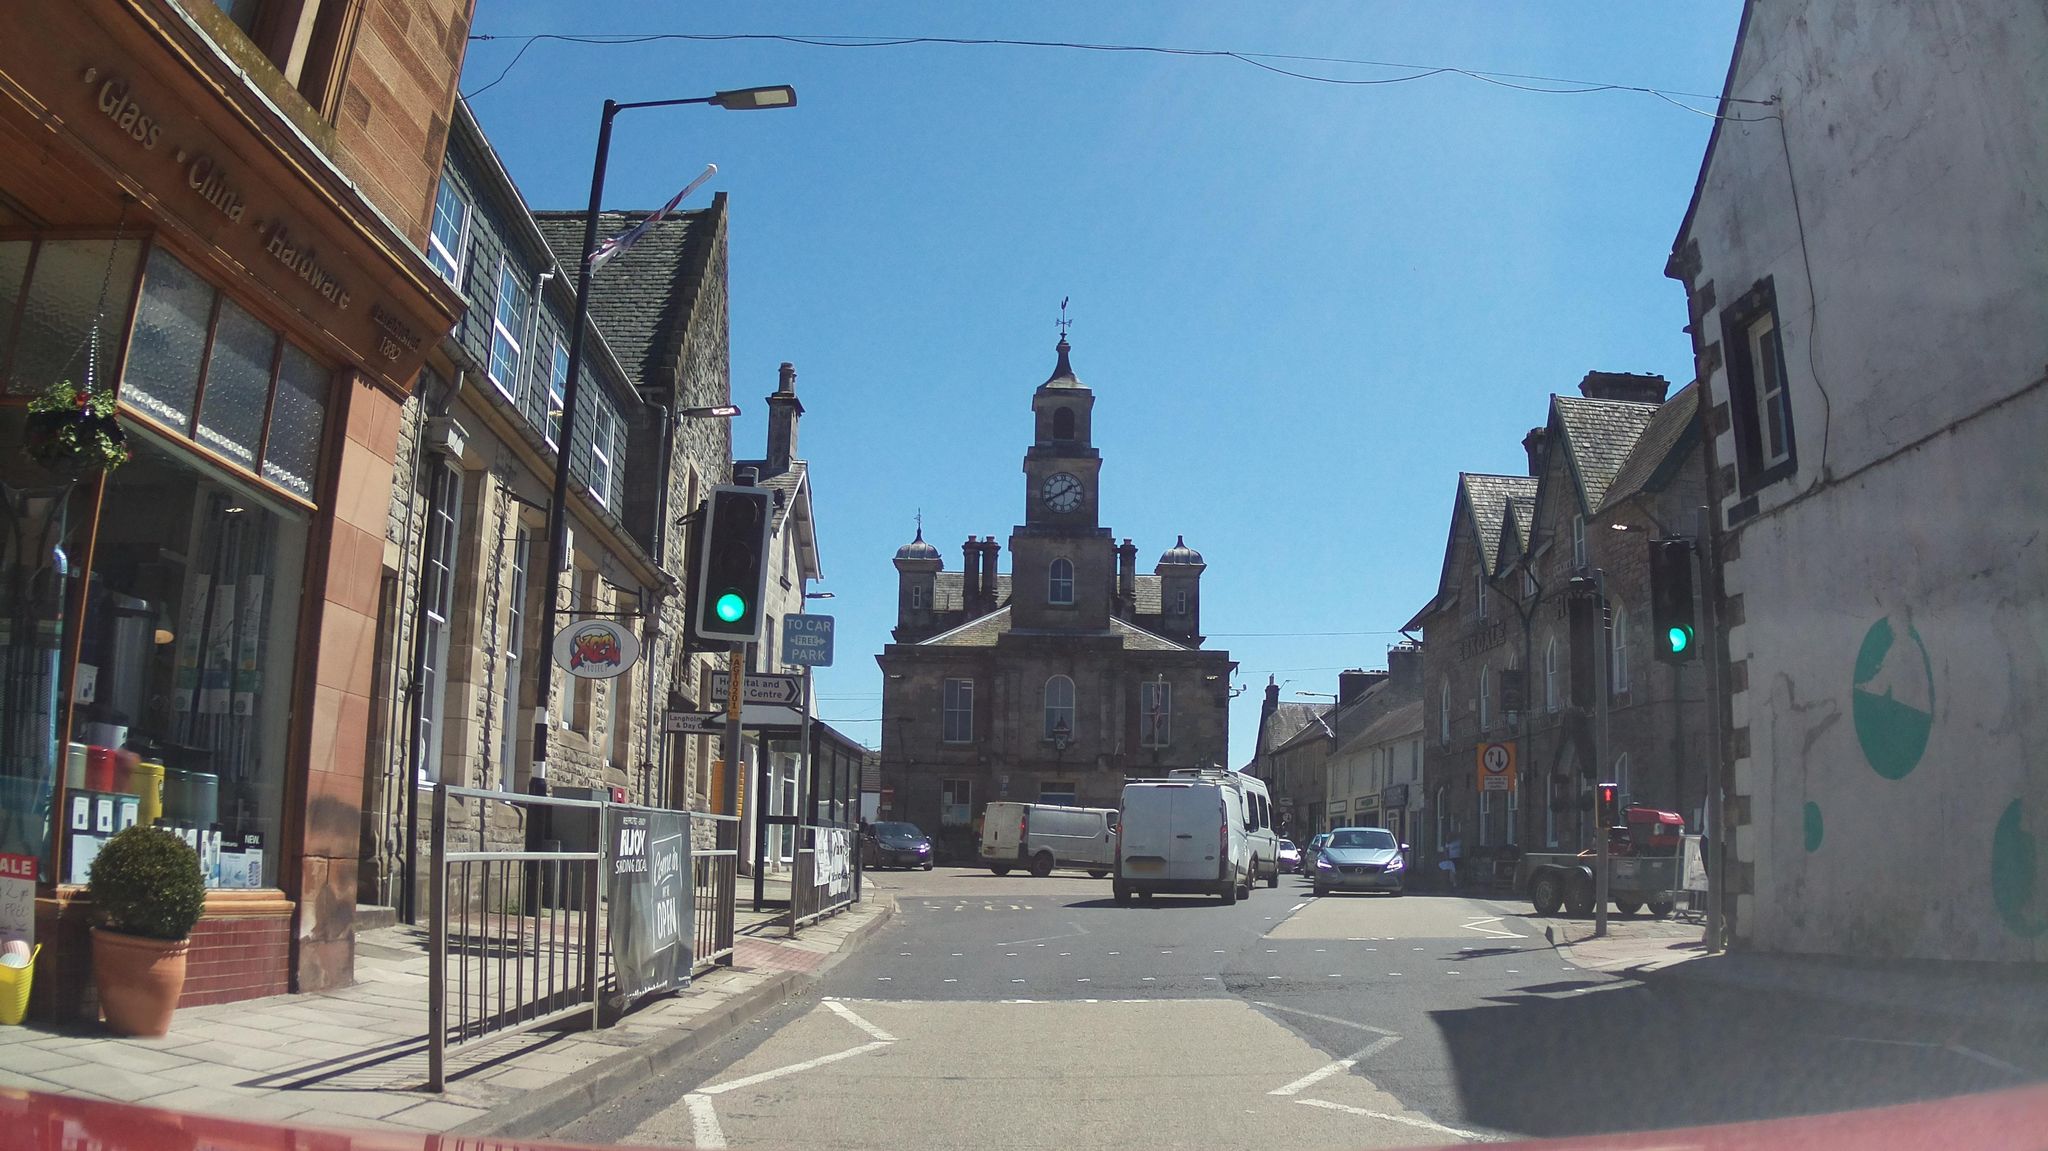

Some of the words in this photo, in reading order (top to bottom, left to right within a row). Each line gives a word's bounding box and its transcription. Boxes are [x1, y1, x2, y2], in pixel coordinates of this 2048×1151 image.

[97, 78, 162, 152] Glass
[187, 157, 247, 225] China
[265, 224, 351, 310] Hardware
[786, 618, 803, 631] TO
[806, 620, 832, 633] CAR
[796, 636, 817, 645] FREE
[791, 648, 826, 661] PARK
[763, 679, 780, 689] and
[750, 688, 783, 699] Centre
[0, 857, 33, 877] ALE
[657, 897, 677, 940] OPEN
